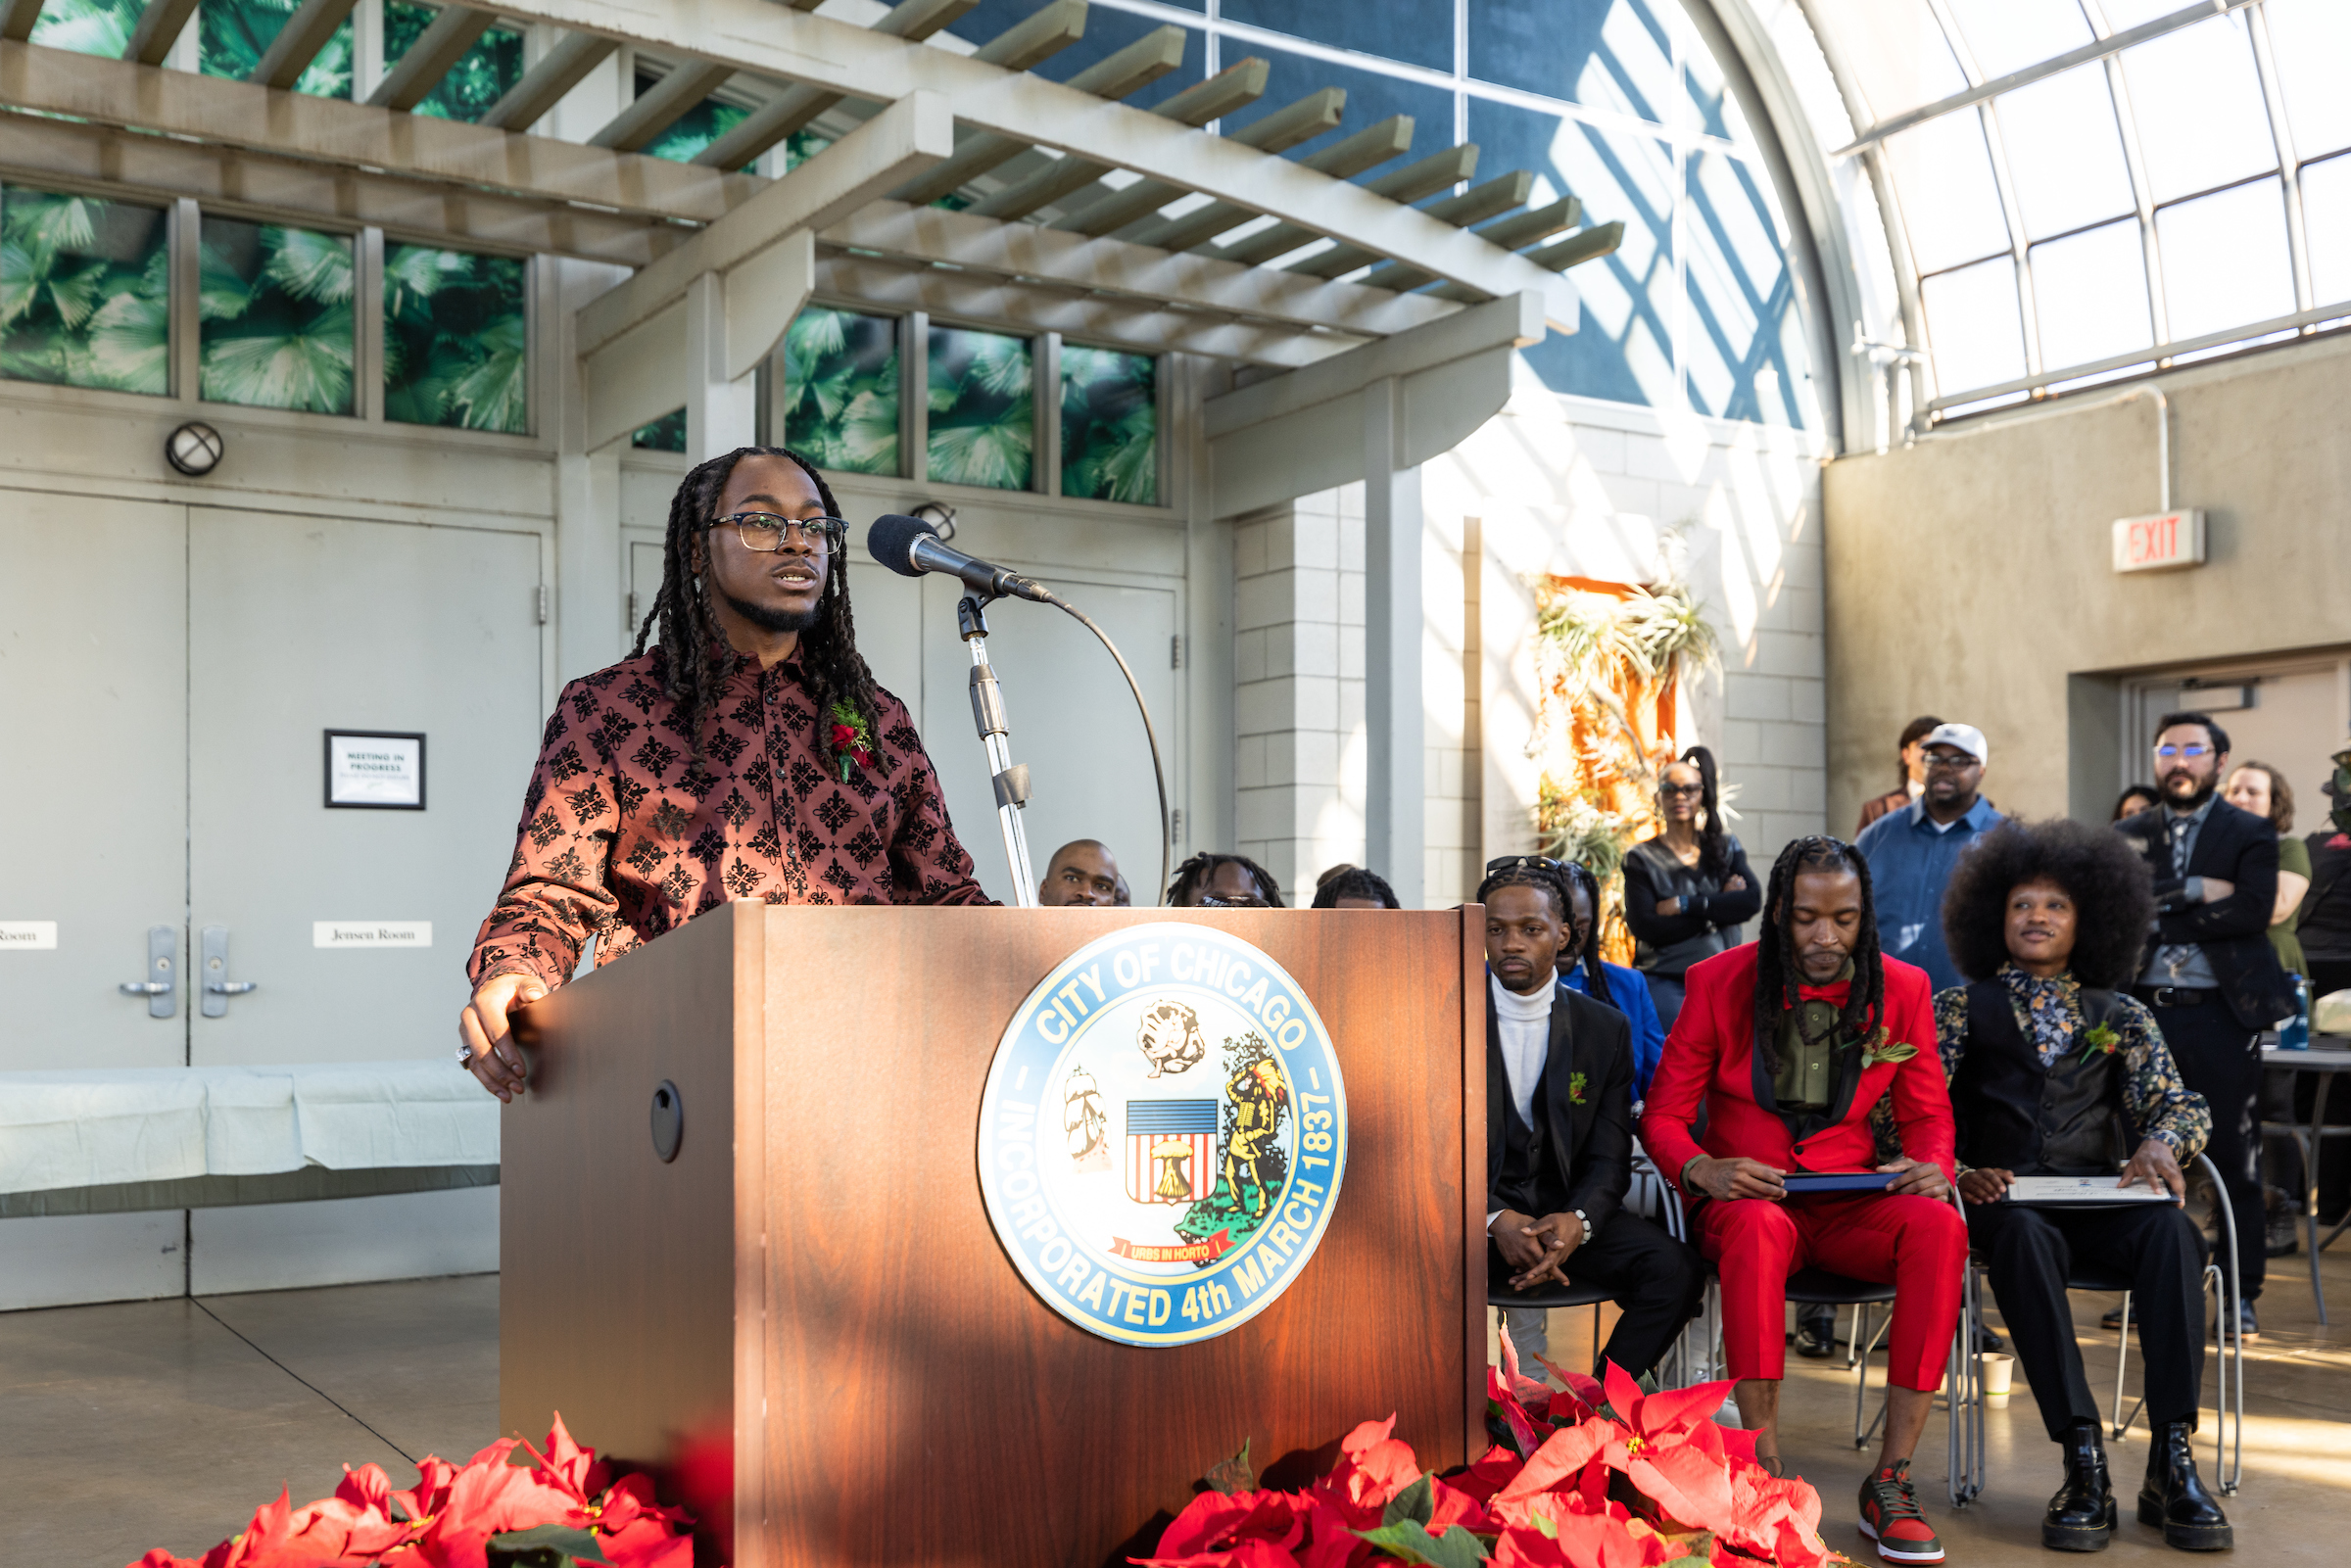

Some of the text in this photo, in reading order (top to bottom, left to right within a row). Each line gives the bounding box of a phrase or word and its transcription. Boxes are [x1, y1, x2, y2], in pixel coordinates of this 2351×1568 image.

[2130, 515, 2181, 562] EXIT
[348, 752, 405, 762] MEETING IN
[350, 762, 402, 772] PROGRESS
[331, 927, 415, 941] Jensen Room
[1036, 943, 1308, 1052] CITY OF CHICAGO
[997, 1092, 1333, 1327] INCORPORATED 4th MARCH 1837
[1130, 1245, 1210, 1261] URBS IN HORTO
